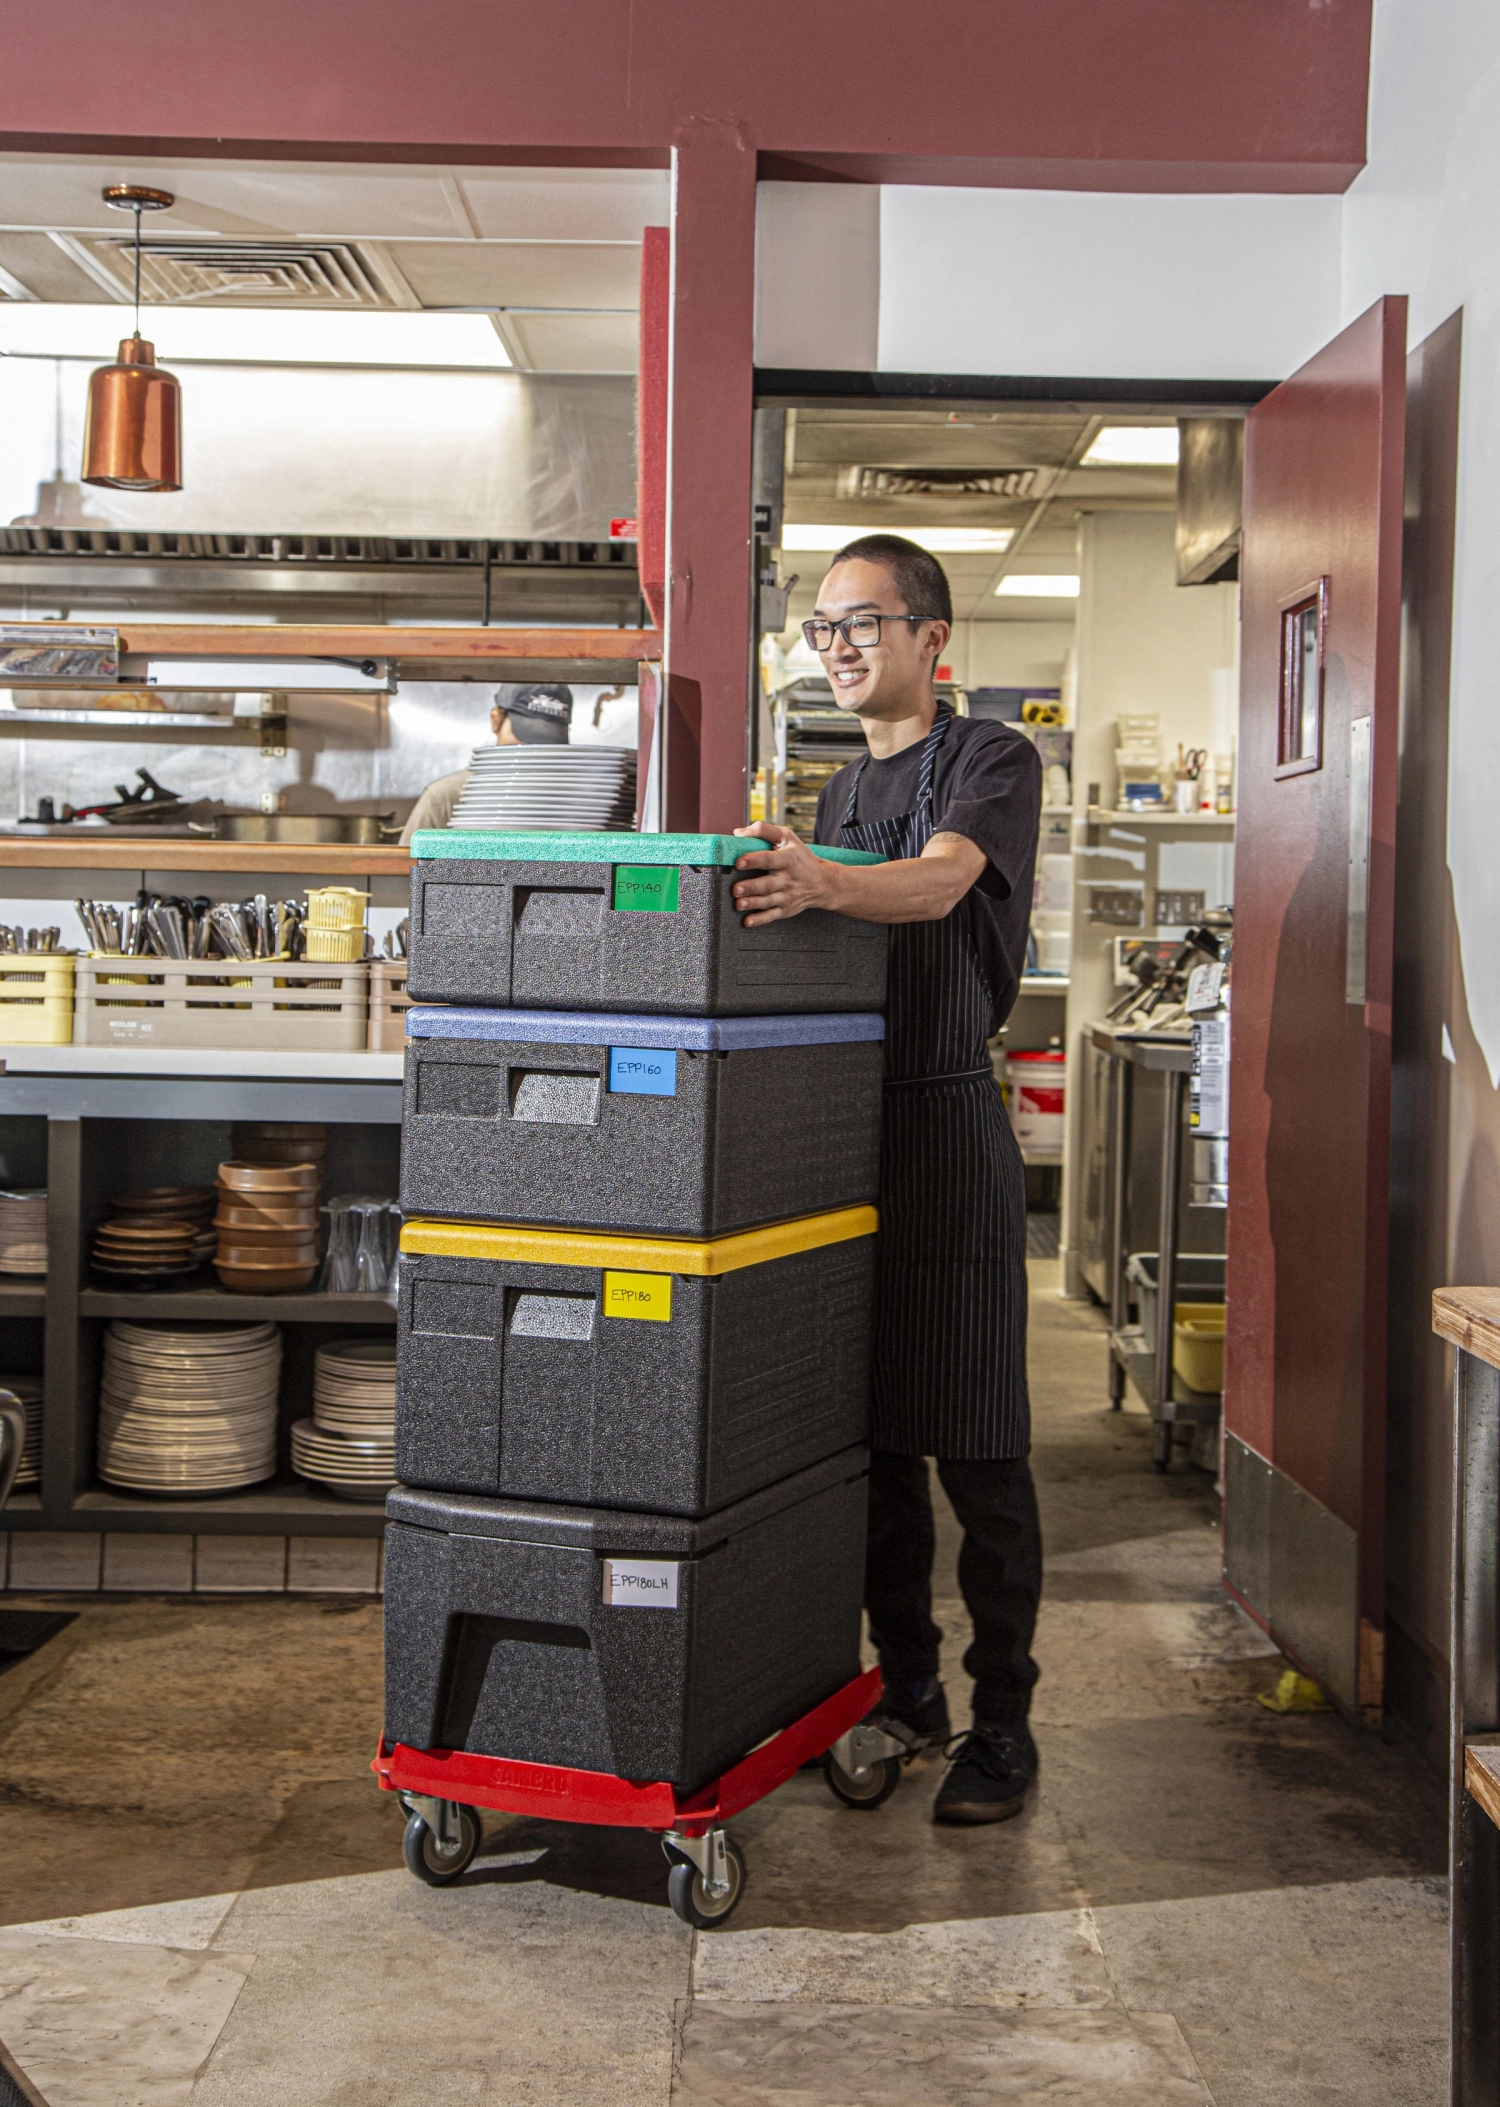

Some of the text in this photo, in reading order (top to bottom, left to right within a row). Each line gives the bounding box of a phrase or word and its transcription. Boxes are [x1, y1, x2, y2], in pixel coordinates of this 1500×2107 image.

[617, 881, 662, 894] EPP140
[617, 1061, 662, 1075] EPP160
[611, 1288, 652, 1302] EPP180
[610, 1573, 669, 1590] EPP180LH
